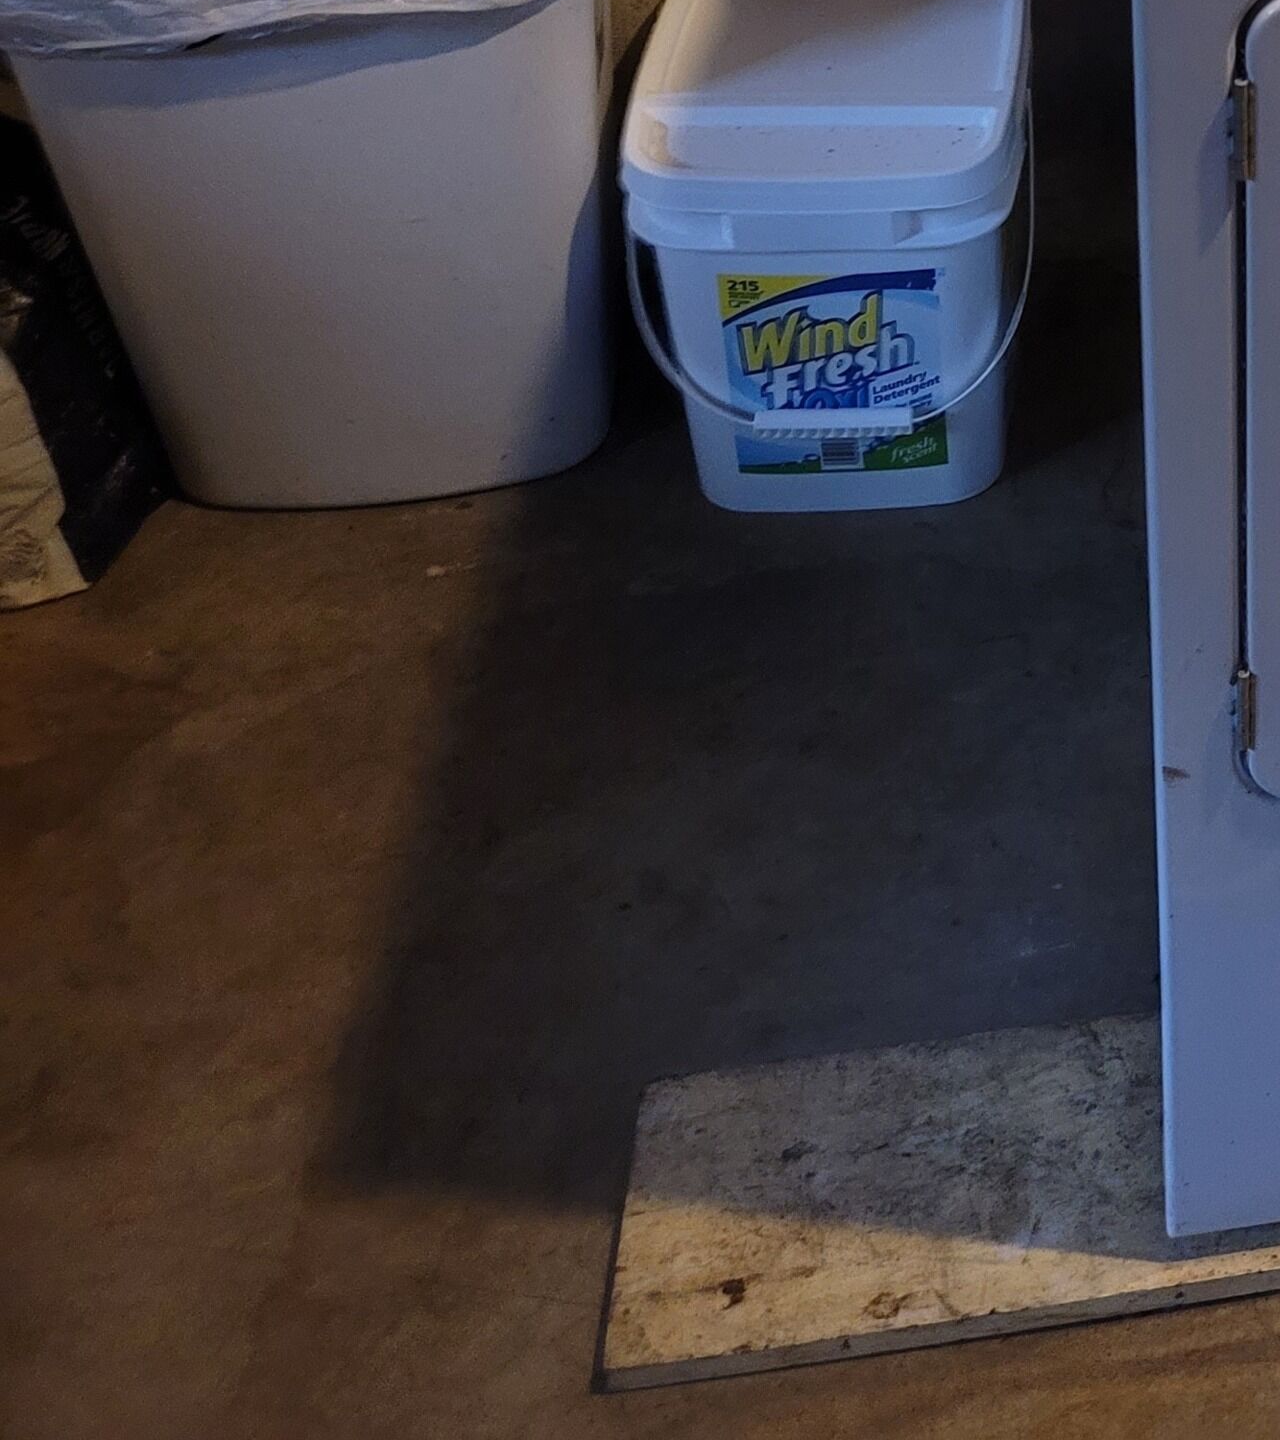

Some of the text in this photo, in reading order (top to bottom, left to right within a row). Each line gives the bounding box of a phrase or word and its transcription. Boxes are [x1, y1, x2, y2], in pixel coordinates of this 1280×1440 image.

[726, 280, 760, 292] 215
[739, 291, 880, 373] Wind
[763, 323, 911, 409] Fresh
[872, 371, 927, 395] Laundry
[873, 375, 941, 405] Detergent
[890, 436, 934, 463] fresh
[902, 442, 938, 464] scent
